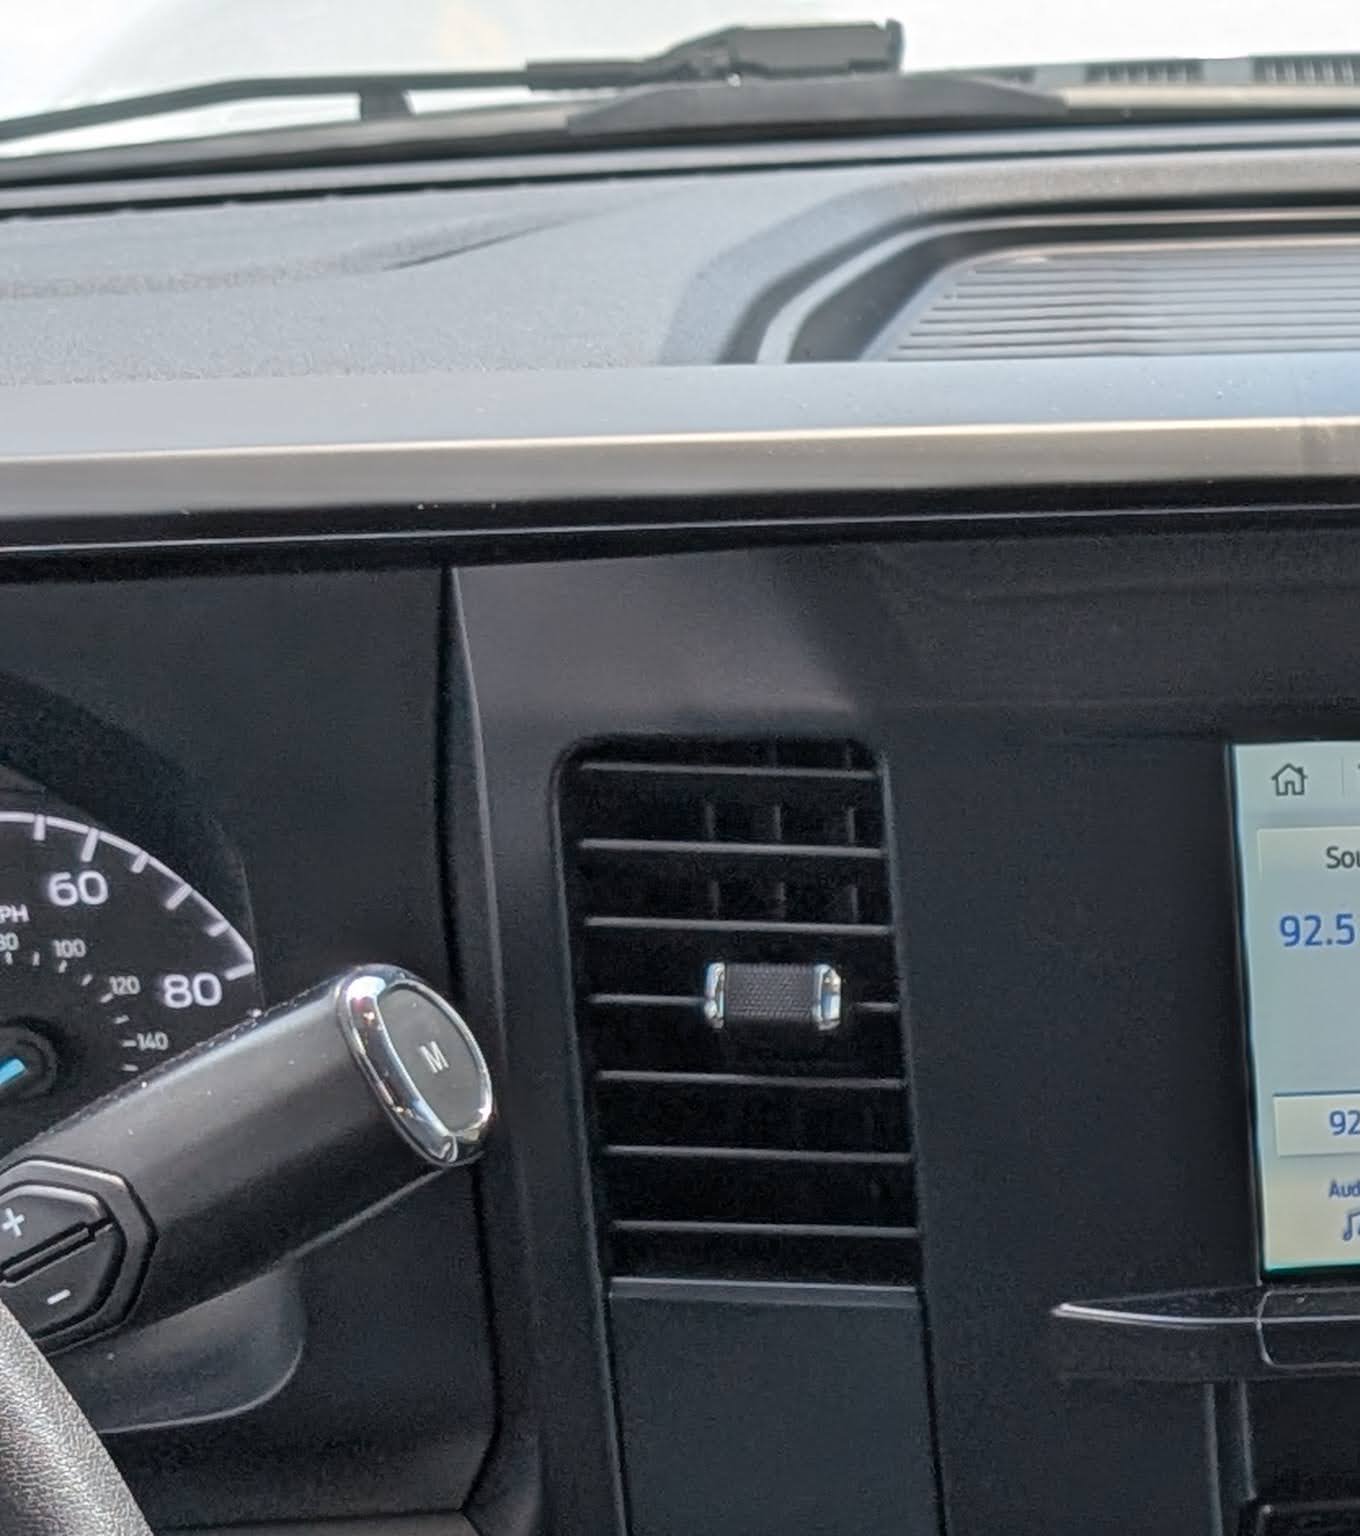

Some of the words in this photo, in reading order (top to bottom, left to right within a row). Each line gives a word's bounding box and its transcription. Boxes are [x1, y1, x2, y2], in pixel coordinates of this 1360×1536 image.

[49, 870, 108, 906] 60
[1280, 914, 1356, 947] 92.5
[53, 939, 86, 958] 100
[109, 976, 140, 995] 120
[163, 972, 222, 1008] 80
[137, 1032, 168, 1051] 140
